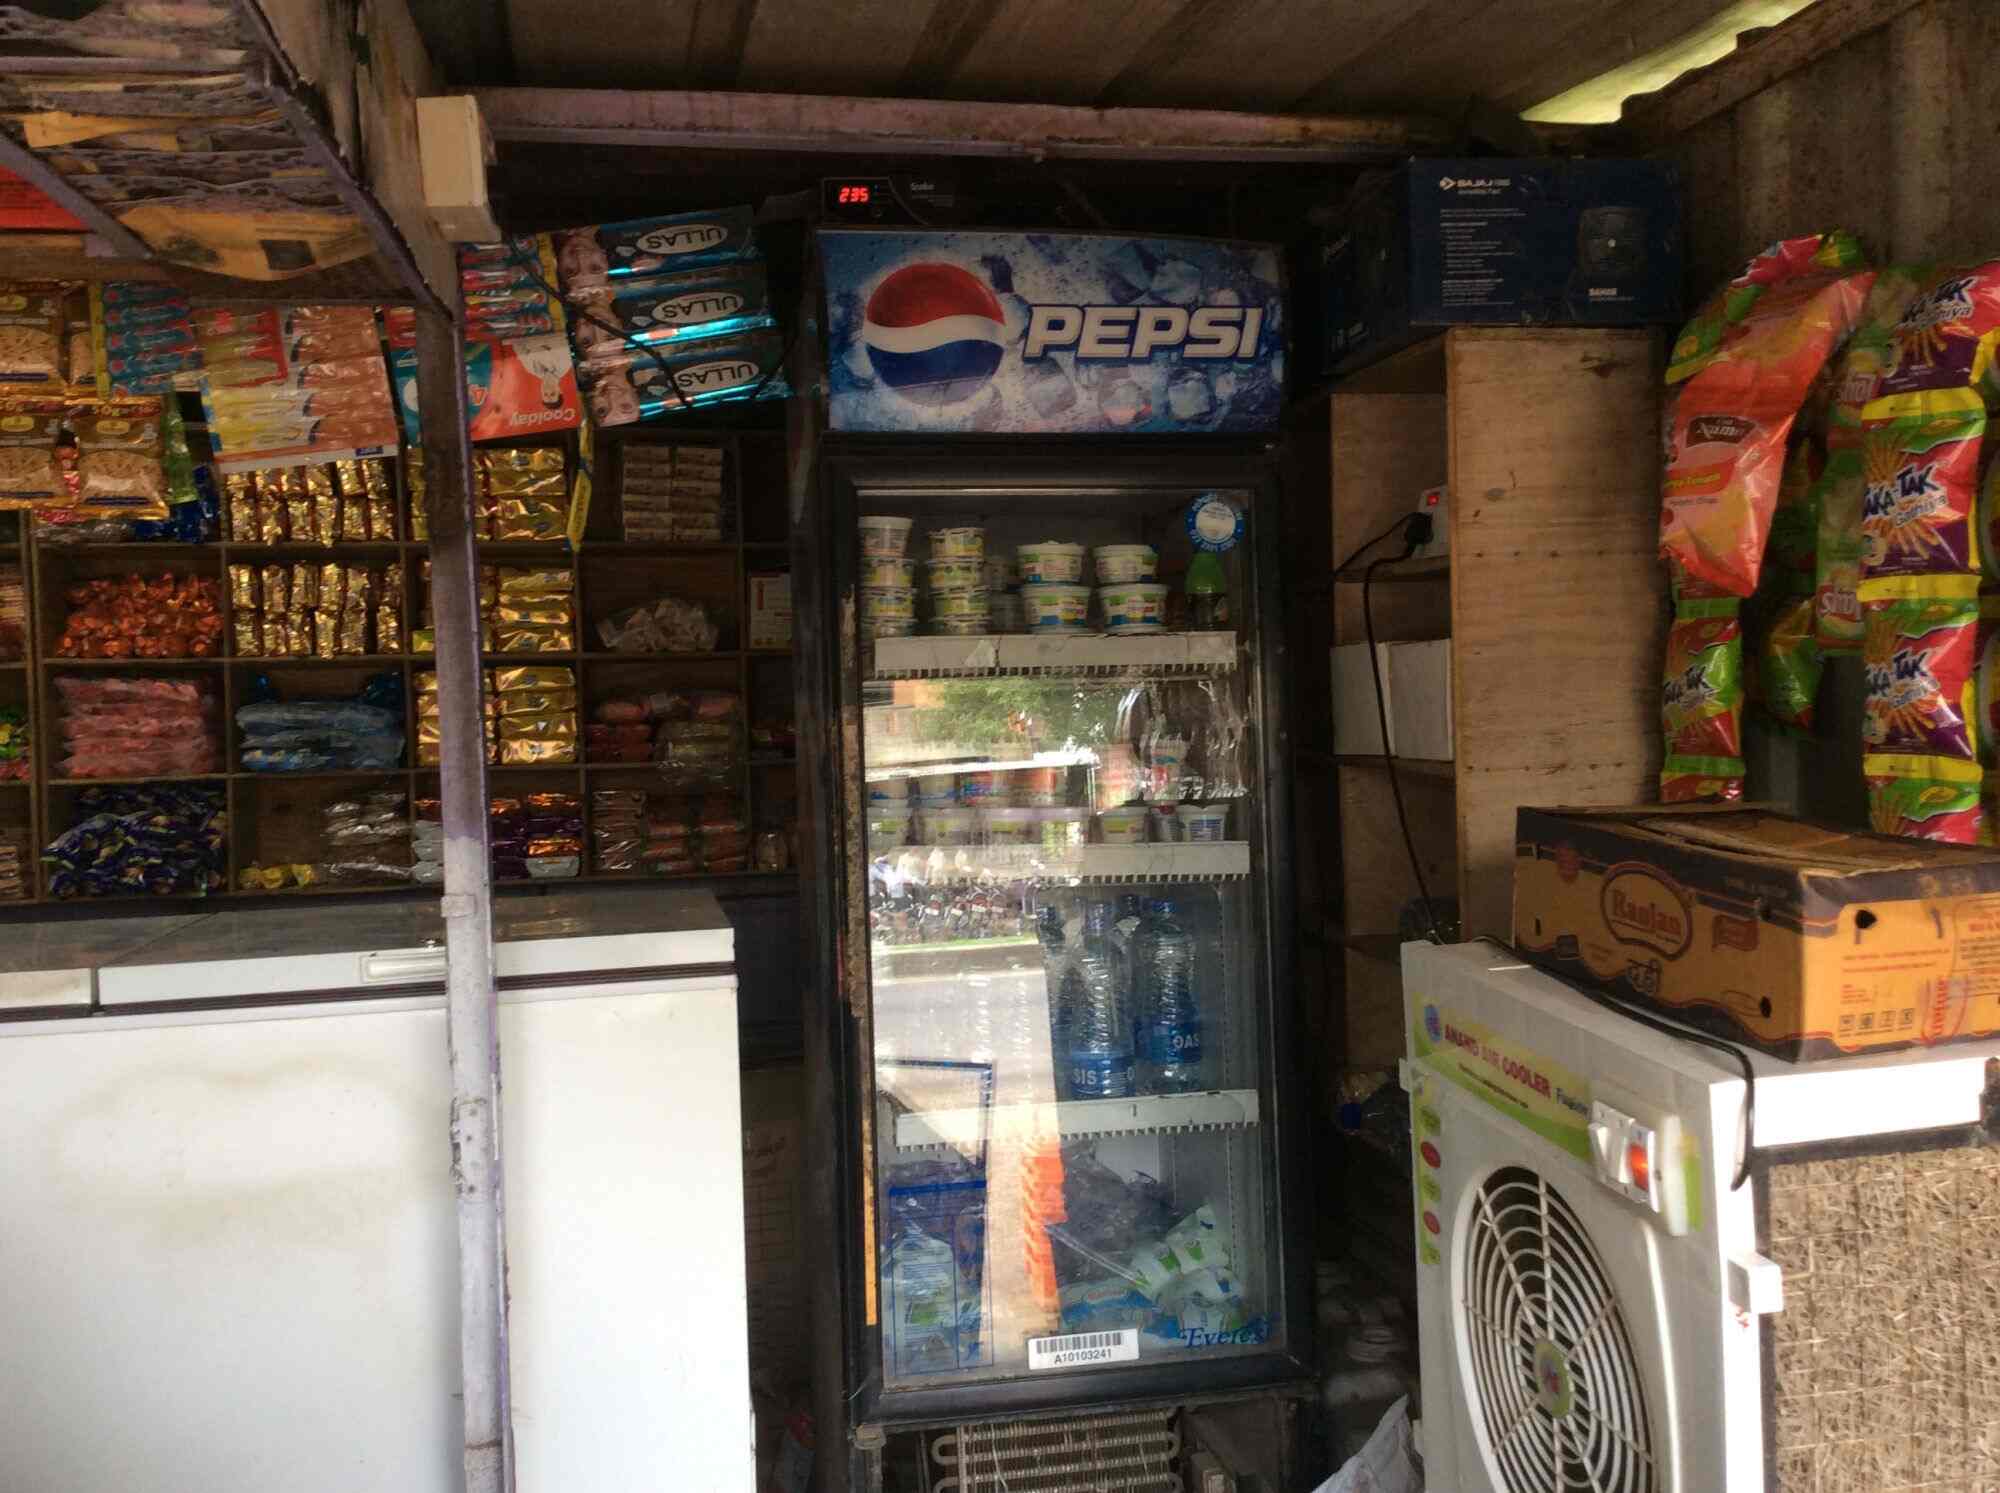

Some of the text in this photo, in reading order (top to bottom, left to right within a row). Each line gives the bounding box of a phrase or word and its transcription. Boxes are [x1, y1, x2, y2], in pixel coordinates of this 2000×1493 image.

[645, 227, 722, 250] ULLAS
[661, 295, 737, 319] ULLAS
[1021, 305, 1264, 359] PEPSI
[676, 363, 754, 388] ULLAS
[509, 407, 577, 428] Coolday
[1502, 1056, 1552, 1099] COOLER
[1053, 1348, 1112, 1365] A10103241
